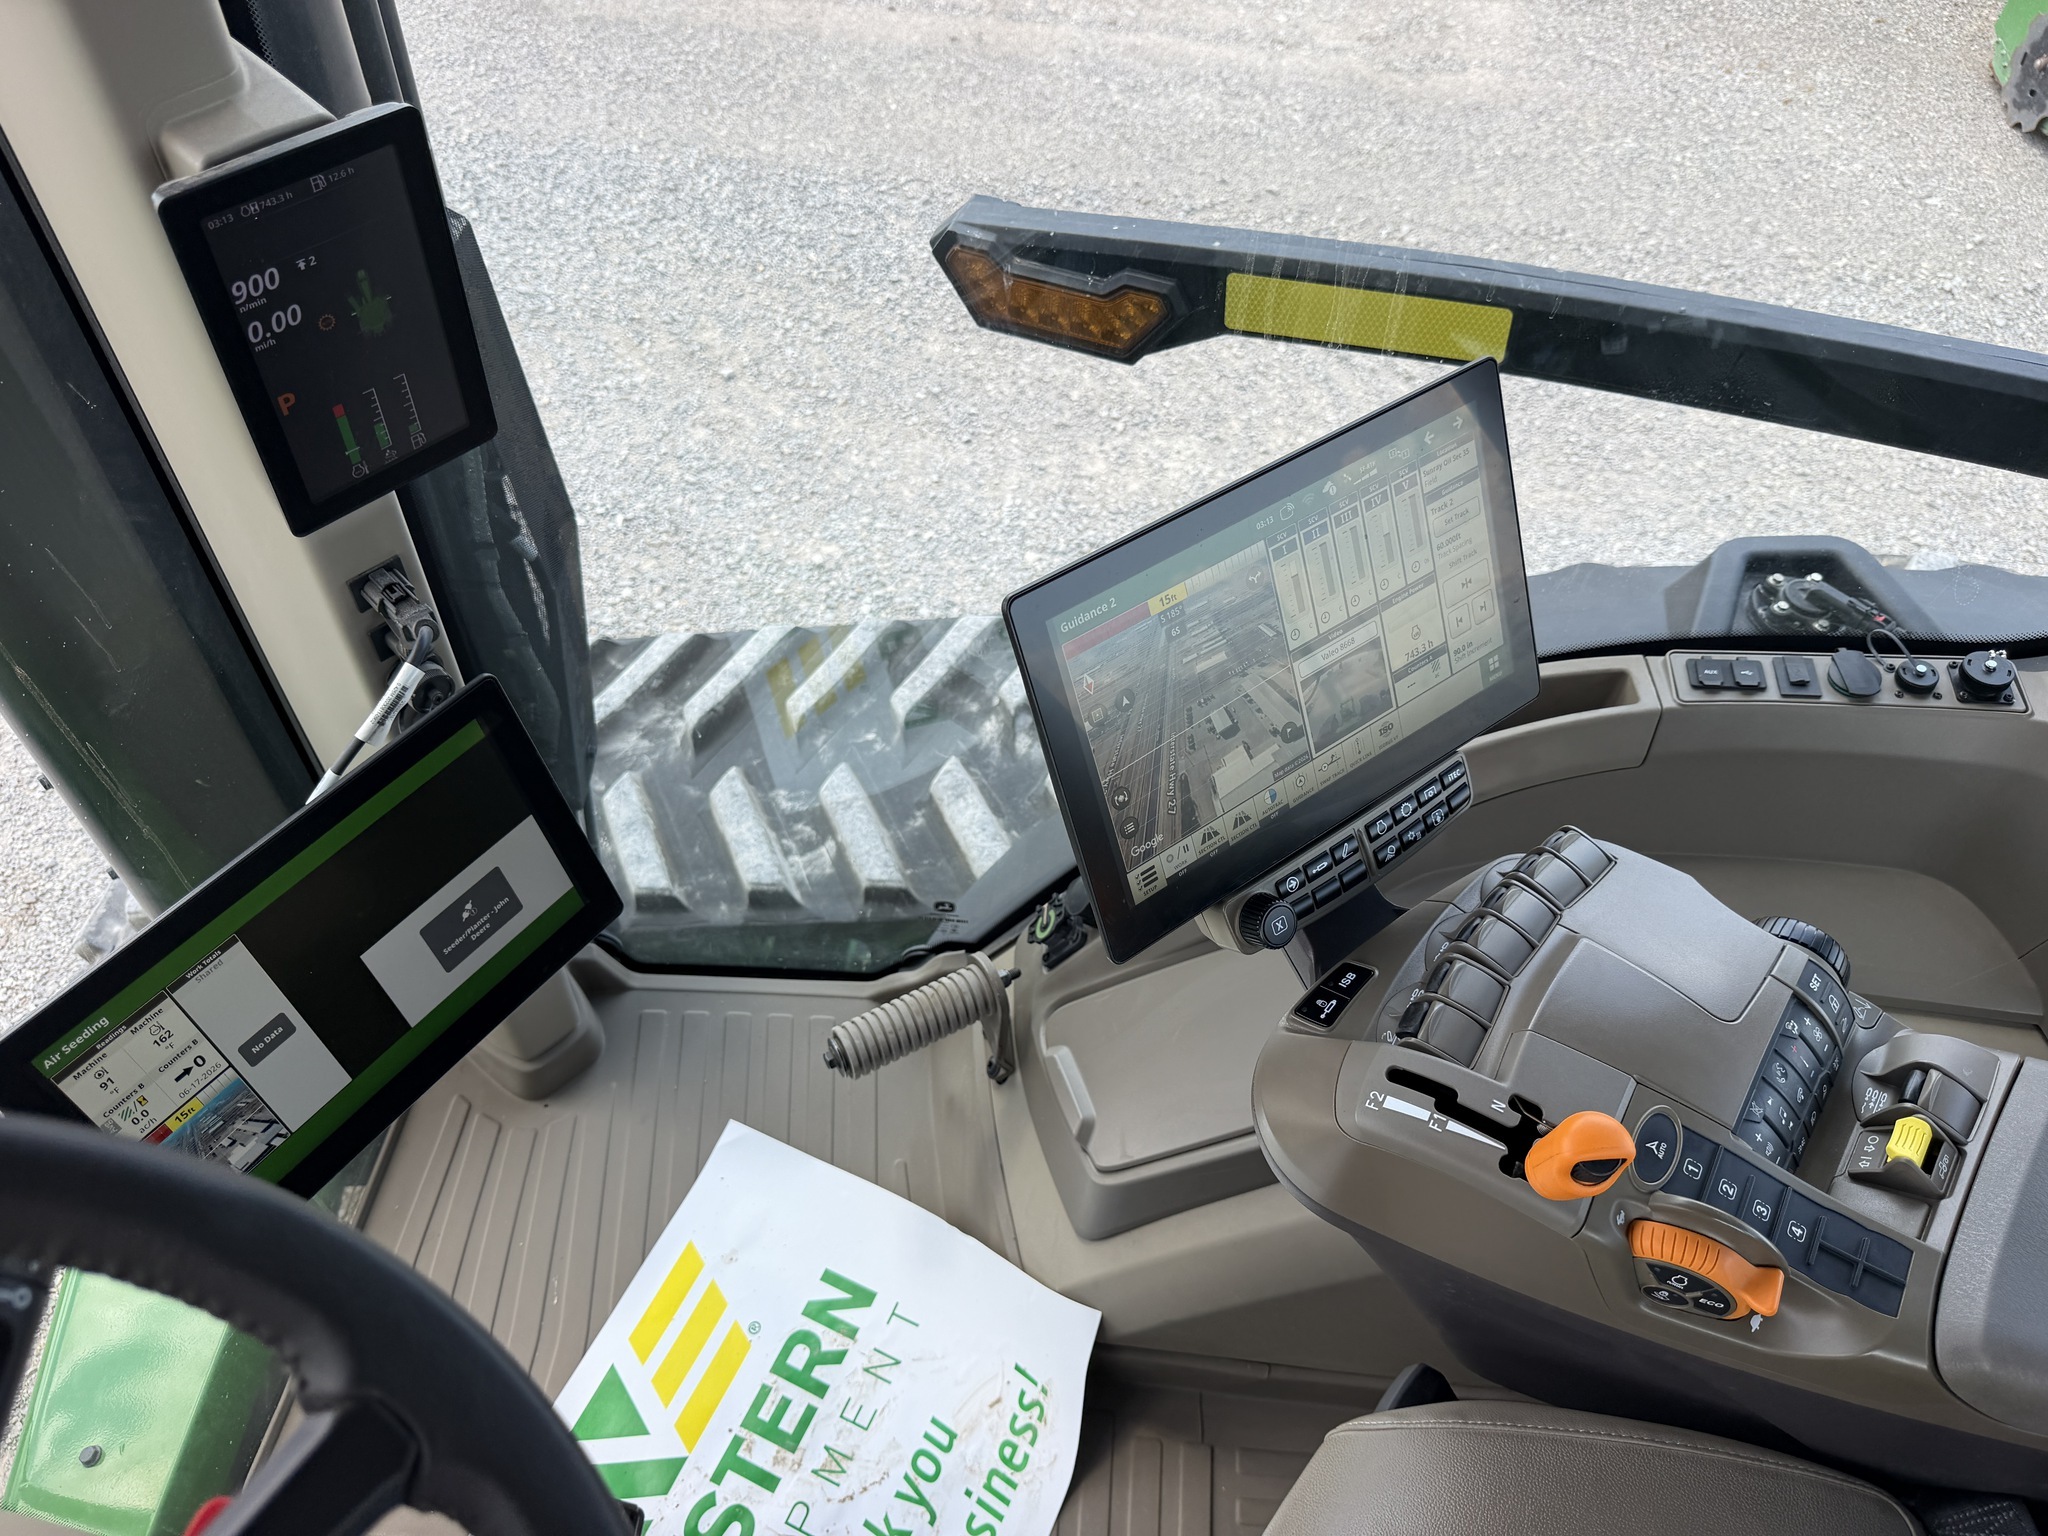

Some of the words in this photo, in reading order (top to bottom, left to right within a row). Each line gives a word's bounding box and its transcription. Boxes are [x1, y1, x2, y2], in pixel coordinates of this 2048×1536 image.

[328, 169, 347, 183] 12.6
[347, 167, 355, 175] h
[259, 194, 285, 209] 743.3
[285, 191, 293, 200] h
[208, 214, 234, 230] 03:13
[308, 256, 317, 266] 2
[231, 267, 280, 305] 900
[239, 296, 267, 313] n/min
[247, 304, 302, 343] 0.00
[254, 338, 277, 352] mi/h
[277, 392, 296, 416] P
[1398, 467, 1409, 477] SCV
[1368, 483, 1379, 493] SCV
[1402, 480, 1409, 491] V
[1441, 480, 1464, 496] Guidance
[1338, 499, 1349, 509] SCV
[1370, 495, 1381, 507] IV
[1430, 501, 1449, 516] Track
[1449, 498, 1454, 506] 2
[1256, 516, 1275, 530] 03:13
[1308, 515, 1319, 525] SCV
[1340, 511, 1352, 525] III
[1444, 516, 1454, 526] Set
[1455, 508, 1469, 521] Track
[1276, 531, 1288, 541] SCV
[1311, 528, 1321, 540] II
[1158, 593, 1178, 607] 15ft
[1060, 603, 1108, 633] Guidance
[1109, 597, 1117, 608] 2
[1160, 614, 1166, 624] S
[1171, 626, 1181, 637] 6S
[1320, 648, 1340, 661] Valeo
[1404, 643, 1427, 662] 743.3
[1427, 640, 1434, 649] h
[1378, 722, 1394, 737] ISO
[1447, 768, 1461, 782] iTEC
[1166, 772, 1176, 797] Hwy
[1167, 799, 1177, 815] 27
[1262, 799, 1284, 816] AUTOTRAC
[1230, 827, 1250, 842] SECTION
[1249, 822, 1258, 831] CTL
[1130, 833, 1164, 857] Google
[1198, 840, 1218, 856] SECTION
[1217, 836, 1226, 844] CTL
[1143, 884, 1158, 897] SETUP
[443, 913, 491, 955] Seeder/Planter
[493, 897, 510, 914] John
[470, 922, 491, 941] Deere
[185, 963, 203, 979] Work
[203, 950, 222, 966] Totals
[195, 958, 224, 983] Shared
[1338, 971, 1357, 988] ISB
[1809, 973, 1822, 992] SET
[130, 1007, 164, 1035] Machine
[43, 1051, 61, 1070] Air
[61, 1016, 110, 1055] Seeding
[95, 1024, 127, 1050] Readings
[152, 1029, 174, 1047] 162
[251, 1041, 265, 1054] No
[264, 1026, 284, 1044] Data
[158, 1044, 192, 1073] Counters
[191, 1038, 199, 1046] B
[193, 1055, 206, 1068] 0
[72, 1052, 108, 1081] Machine
[99, 1077, 115, 1091] 91
[178, 1061, 222, 1099] 06-17-2026
[103, 1089, 138, 1118] Counters
[137, 1082, 145, 1090] B
[1365, 1090, 1385, 1111] F2
[1491, 1099, 1507, 1113] N
[131, 1109, 150, 1126] 0.0
[174, 1107, 196, 1123] 15ft
[1428, 1111, 1447, 1132] F1
[139, 1116, 158, 1134] ac/h
[1657, 1142, 1668, 1160] AUTO
[1687, 1164, 1700, 1175] 1
[1722, 1183, 1734, 1195] 2
[1756, 1205, 1768, 1217] 3
[1791, 1225, 1803, 1238] 4
[1698, 1297, 1725, 1309] ECO
[893, 1415, 958, 1527] you
